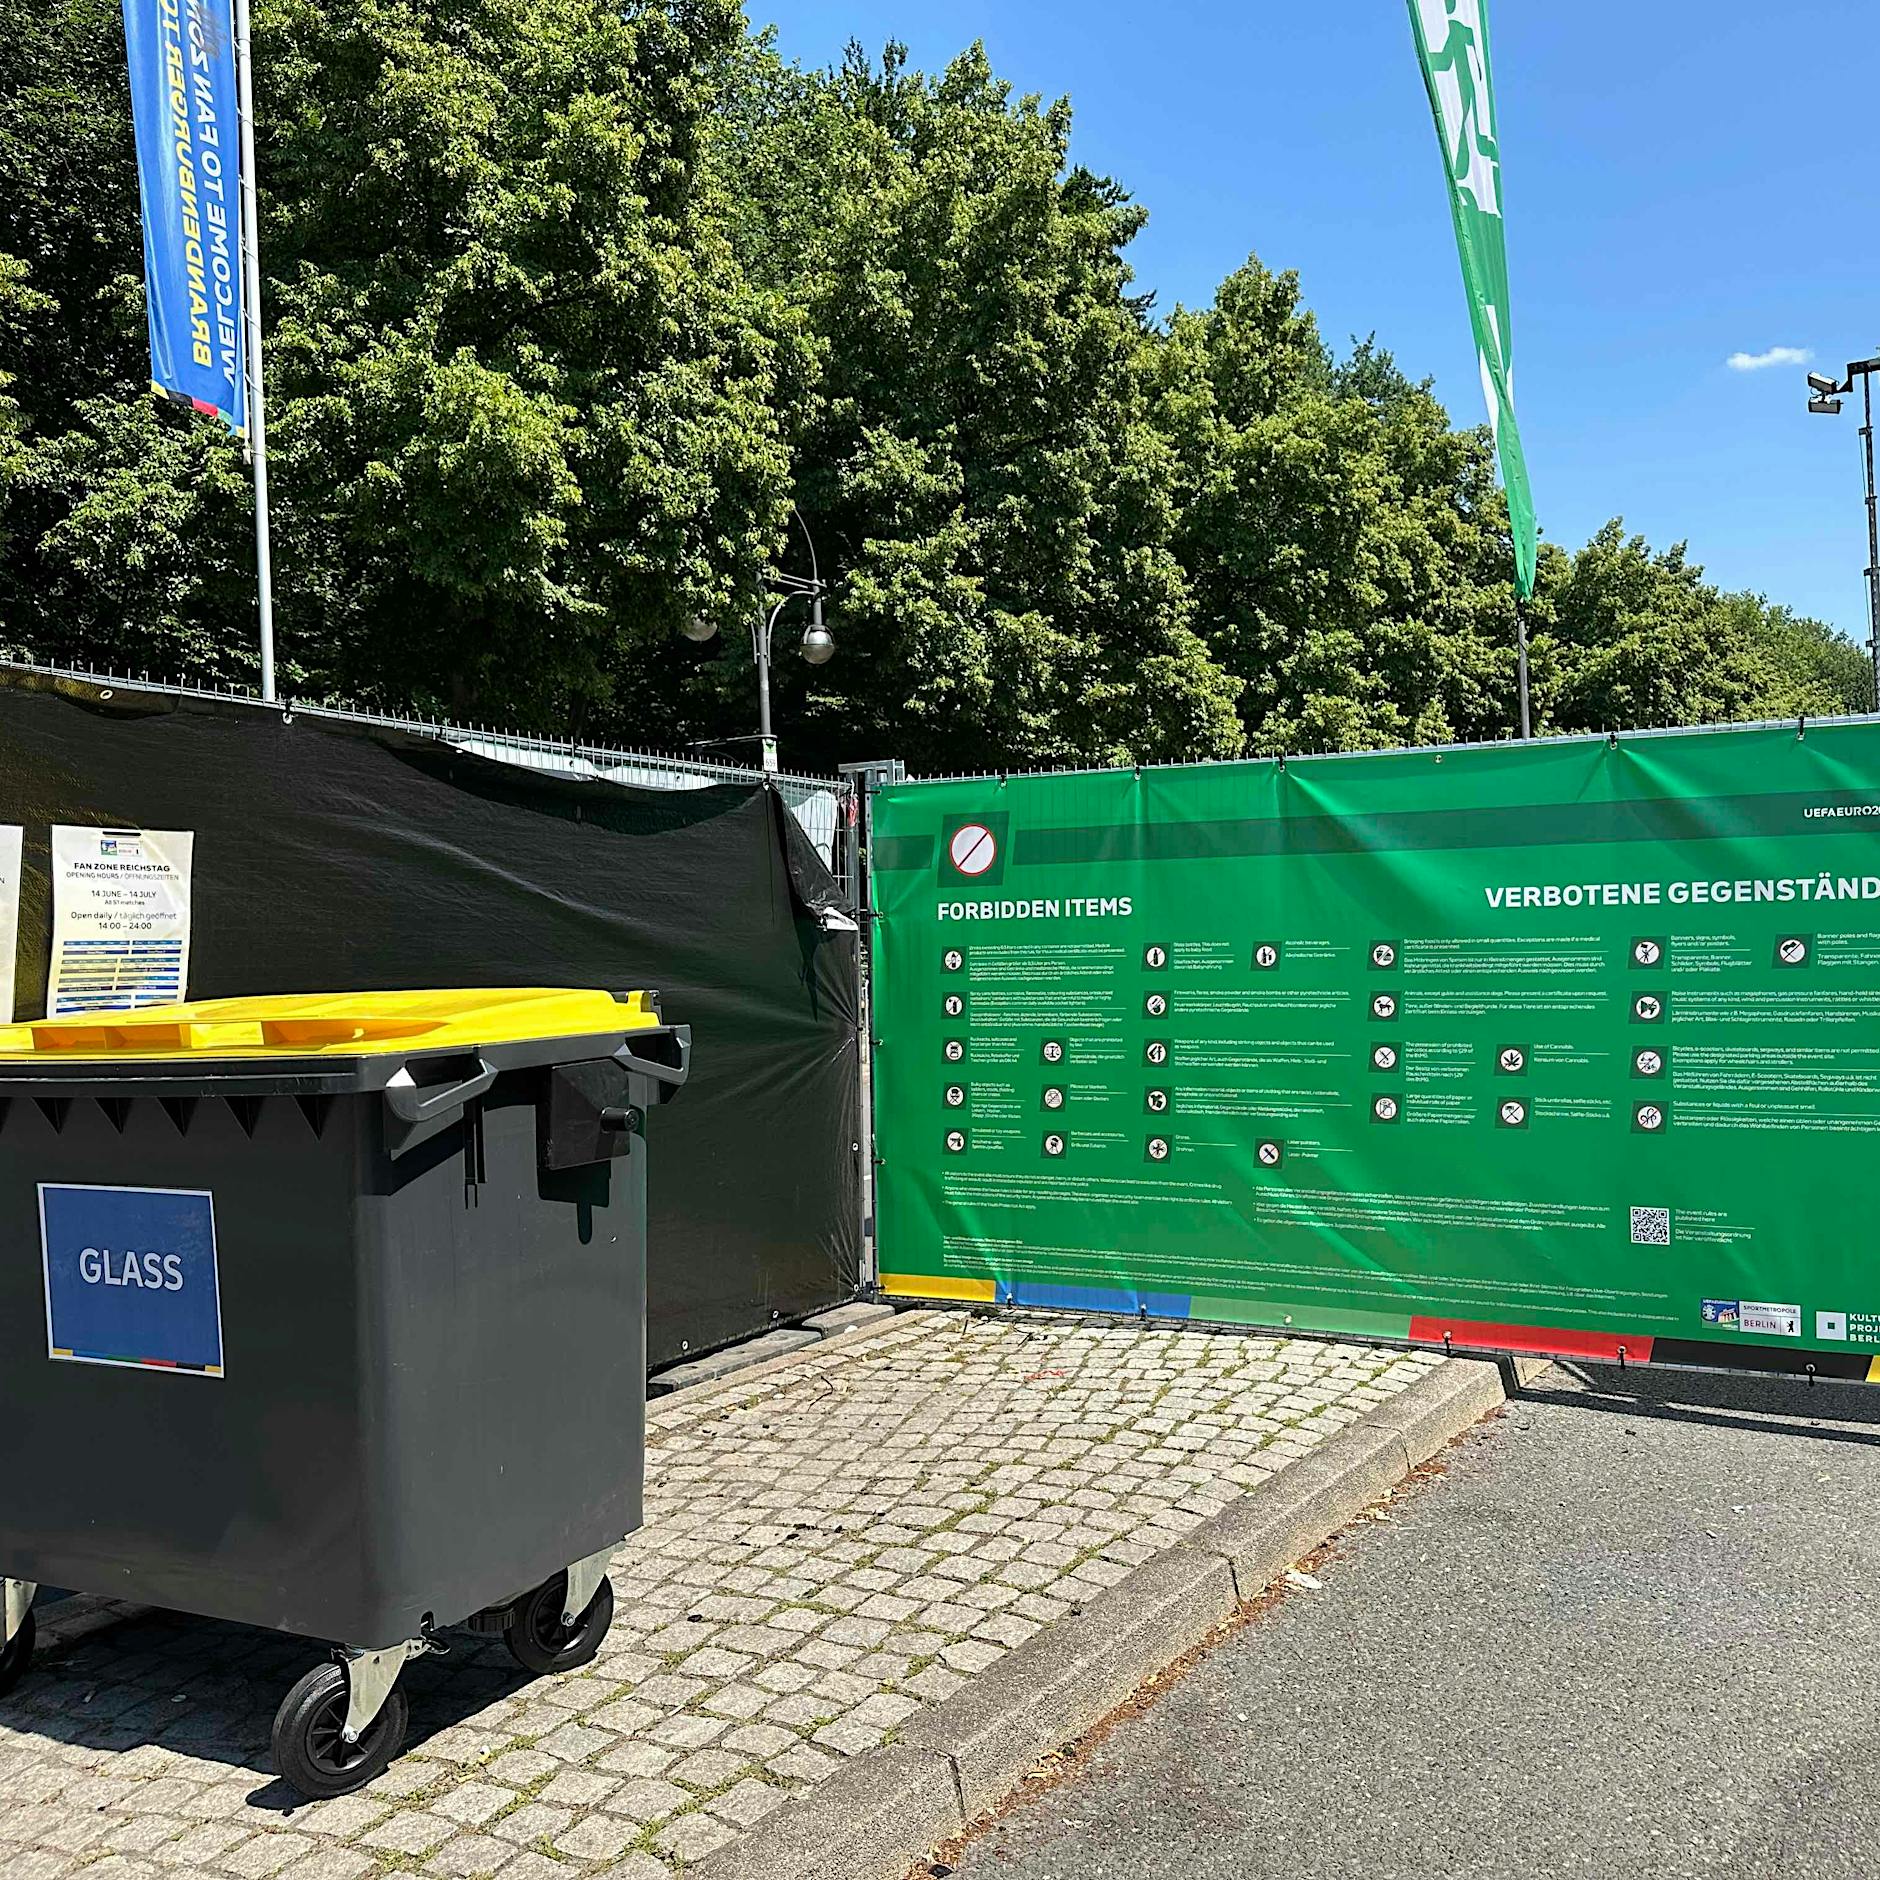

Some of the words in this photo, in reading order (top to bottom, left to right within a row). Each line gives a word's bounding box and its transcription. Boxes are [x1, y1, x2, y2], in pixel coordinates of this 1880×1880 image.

[1803, 805, 1880, 818] UEFAEURO2
[74, 862, 92, 870] FAN
[94, 863, 118, 871] ZONE
[120, 864, 170, 872] REICHSTAG
[66, 871, 95, 879] OPENING
[96, 872, 119, 880] HOURS
[102, 890, 122, 898] JUNE
[139, 890, 156, 898] JULY
[1485, 882, 1661, 908] VERBOTENE
[937, 899, 1060, 921] FORBIDDEN
[1065, 897, 1133, 917] ITEMS
[71, 911, 92, 920] Open
[93, 911, 112, 921] daily
[145, 911, 177, 921] geöffnet
[79, 1247, 184, 1292] GLASS
[1743, 1305, 1796, 1314] SPORTMETROPOLE
[1850, 1313, 1880, 1322] KULT
[1744, 1319, 1776, 1329] BERLIN
[1850, 1323, 1880, 1333] PROJ
